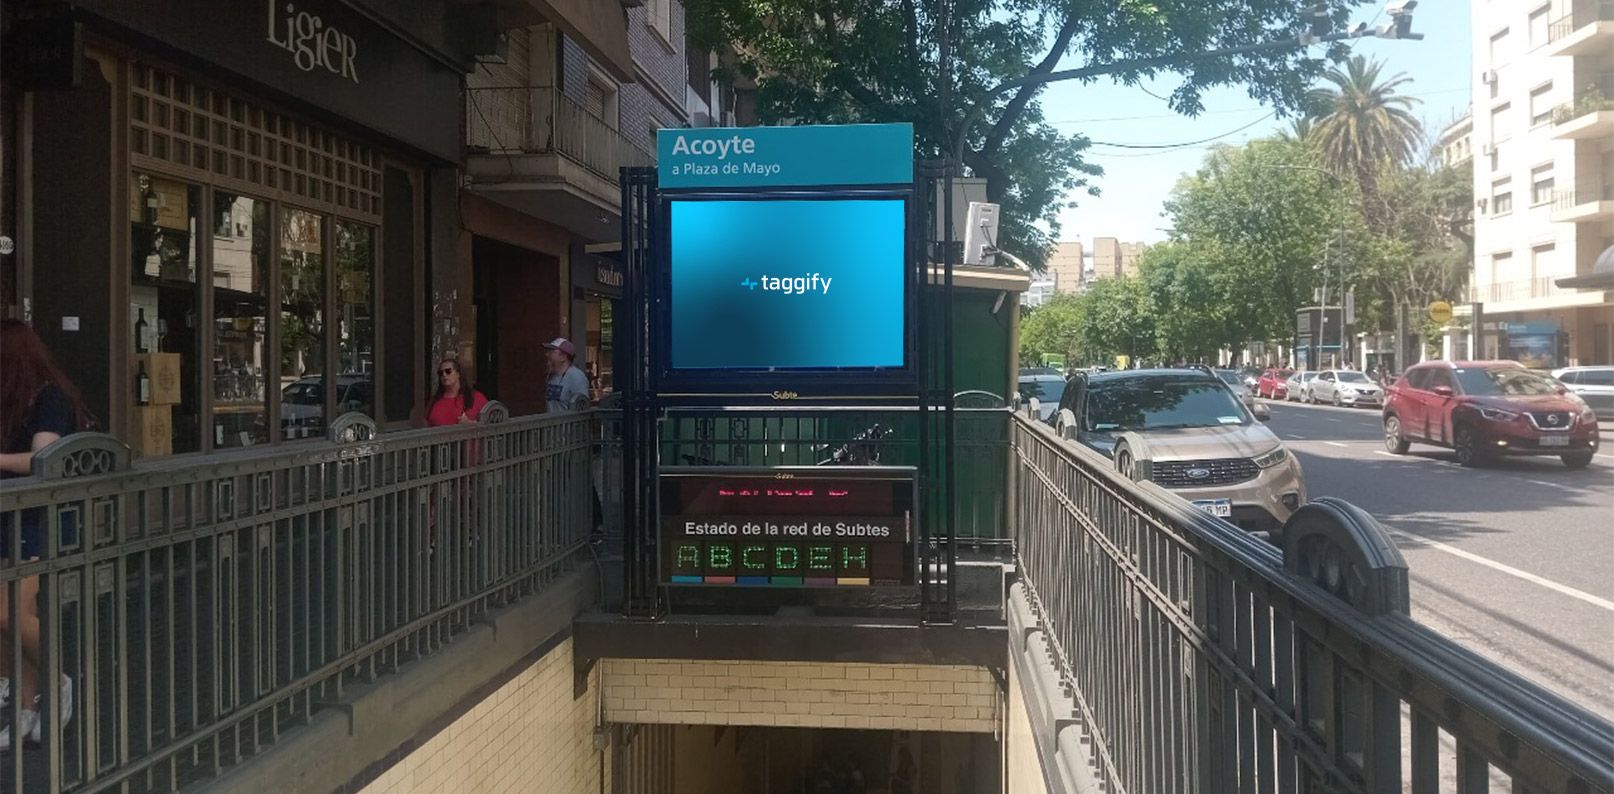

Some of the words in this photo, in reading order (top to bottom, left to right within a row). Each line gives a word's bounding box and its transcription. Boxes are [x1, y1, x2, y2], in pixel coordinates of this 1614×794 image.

[672, 135, 755, 160] Acoyte
[672, 165, 680, 175] a
[684, 163, 718, 175] Plaza
[722, 162, 739, 174] de
[743, 162, 781, 177] Mayo
[761, 273, 832, 294] taggify
[771, 390, 799, 400] Subte
[685, 522, 737, 535] Estado
[742, 522, 761, 535] de
[765, 522, 778, 535] la
[783, 522, 808, 536] red
[812, 523, 832, 536] de
[835, 522, 890, 537] Subtes
[678, 546, 699, 568] A
[710, 546, 732, 568] B
[743, 547, 765, 569] C
[776, 547, 798, 569] D
[808, 547, 832, 569] E
[842, 547, 866, 569] H
